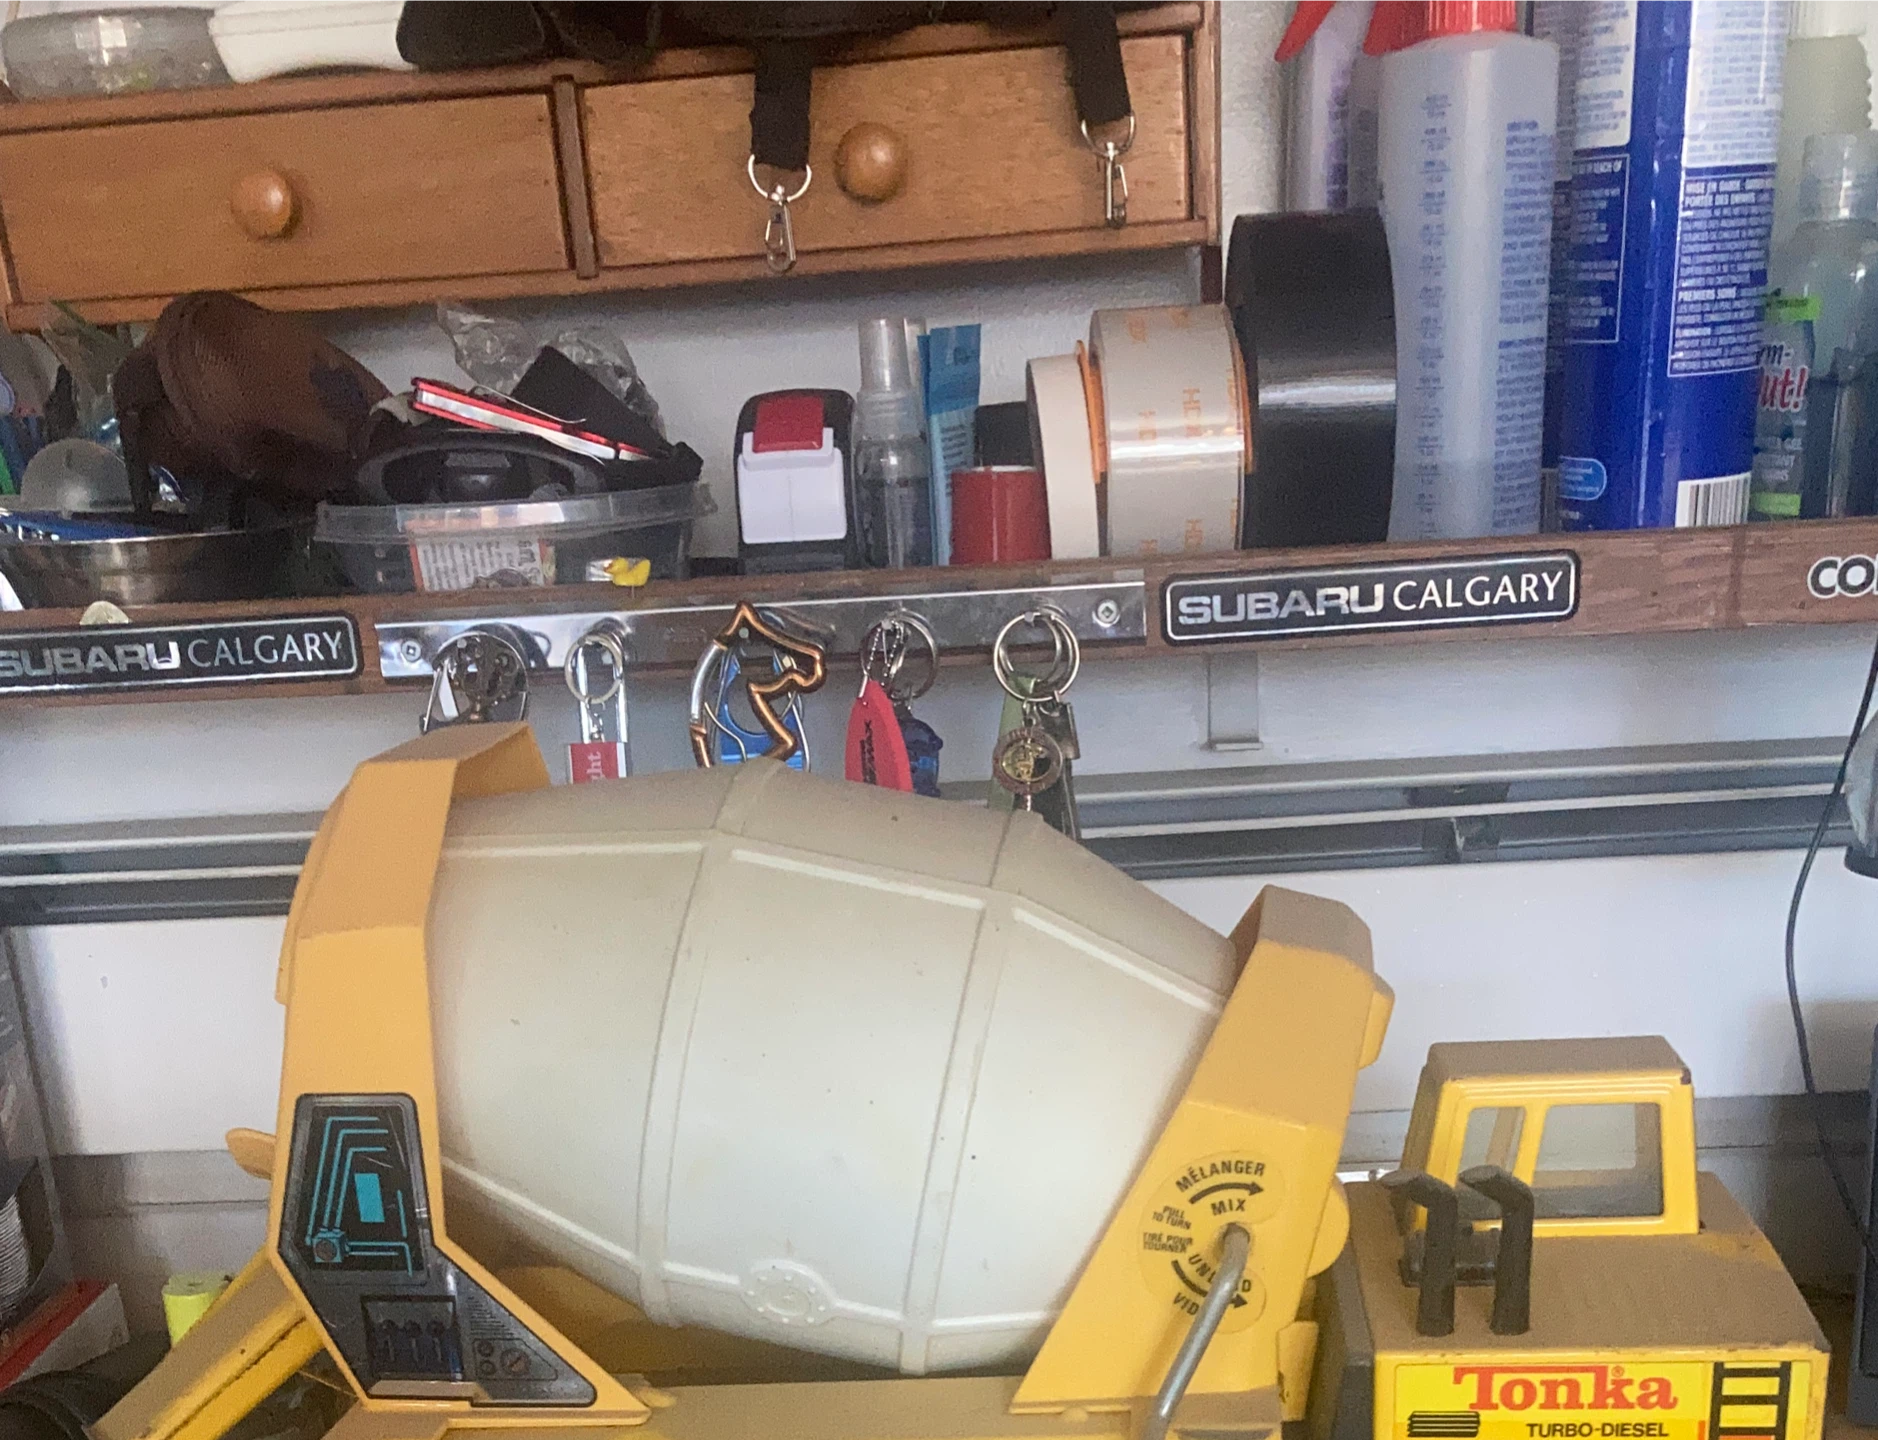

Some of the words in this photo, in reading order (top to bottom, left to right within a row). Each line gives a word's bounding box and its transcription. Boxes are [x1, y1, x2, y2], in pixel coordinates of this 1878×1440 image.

[1760, 367, 1807, 409] ut!
[1807, 554, 1878, 598] CO
[1178, 584, 1385, 625] SUBARU
[1392, 571, 1563, 612] CALGARY
[0, 641, 182, 678] SUBARU
[187, 631, 343, 668] CALGARY
[1175, 1160, 1266, 1193] MÉLANGER
[1152, 1211, 1164, 1223] TO
[1165, 1215, 1192, 1230] TURN
[1162, 1205, 1185, 1219] PULL
[1211, 1199, 1246, 1217] MIX
[1188, 1253, 1252, 1294] UNLD
[1452, 1365, 1678, 1411] Tonka
[1526, 1422, 1670, 1439] TURBO-DIESEL
